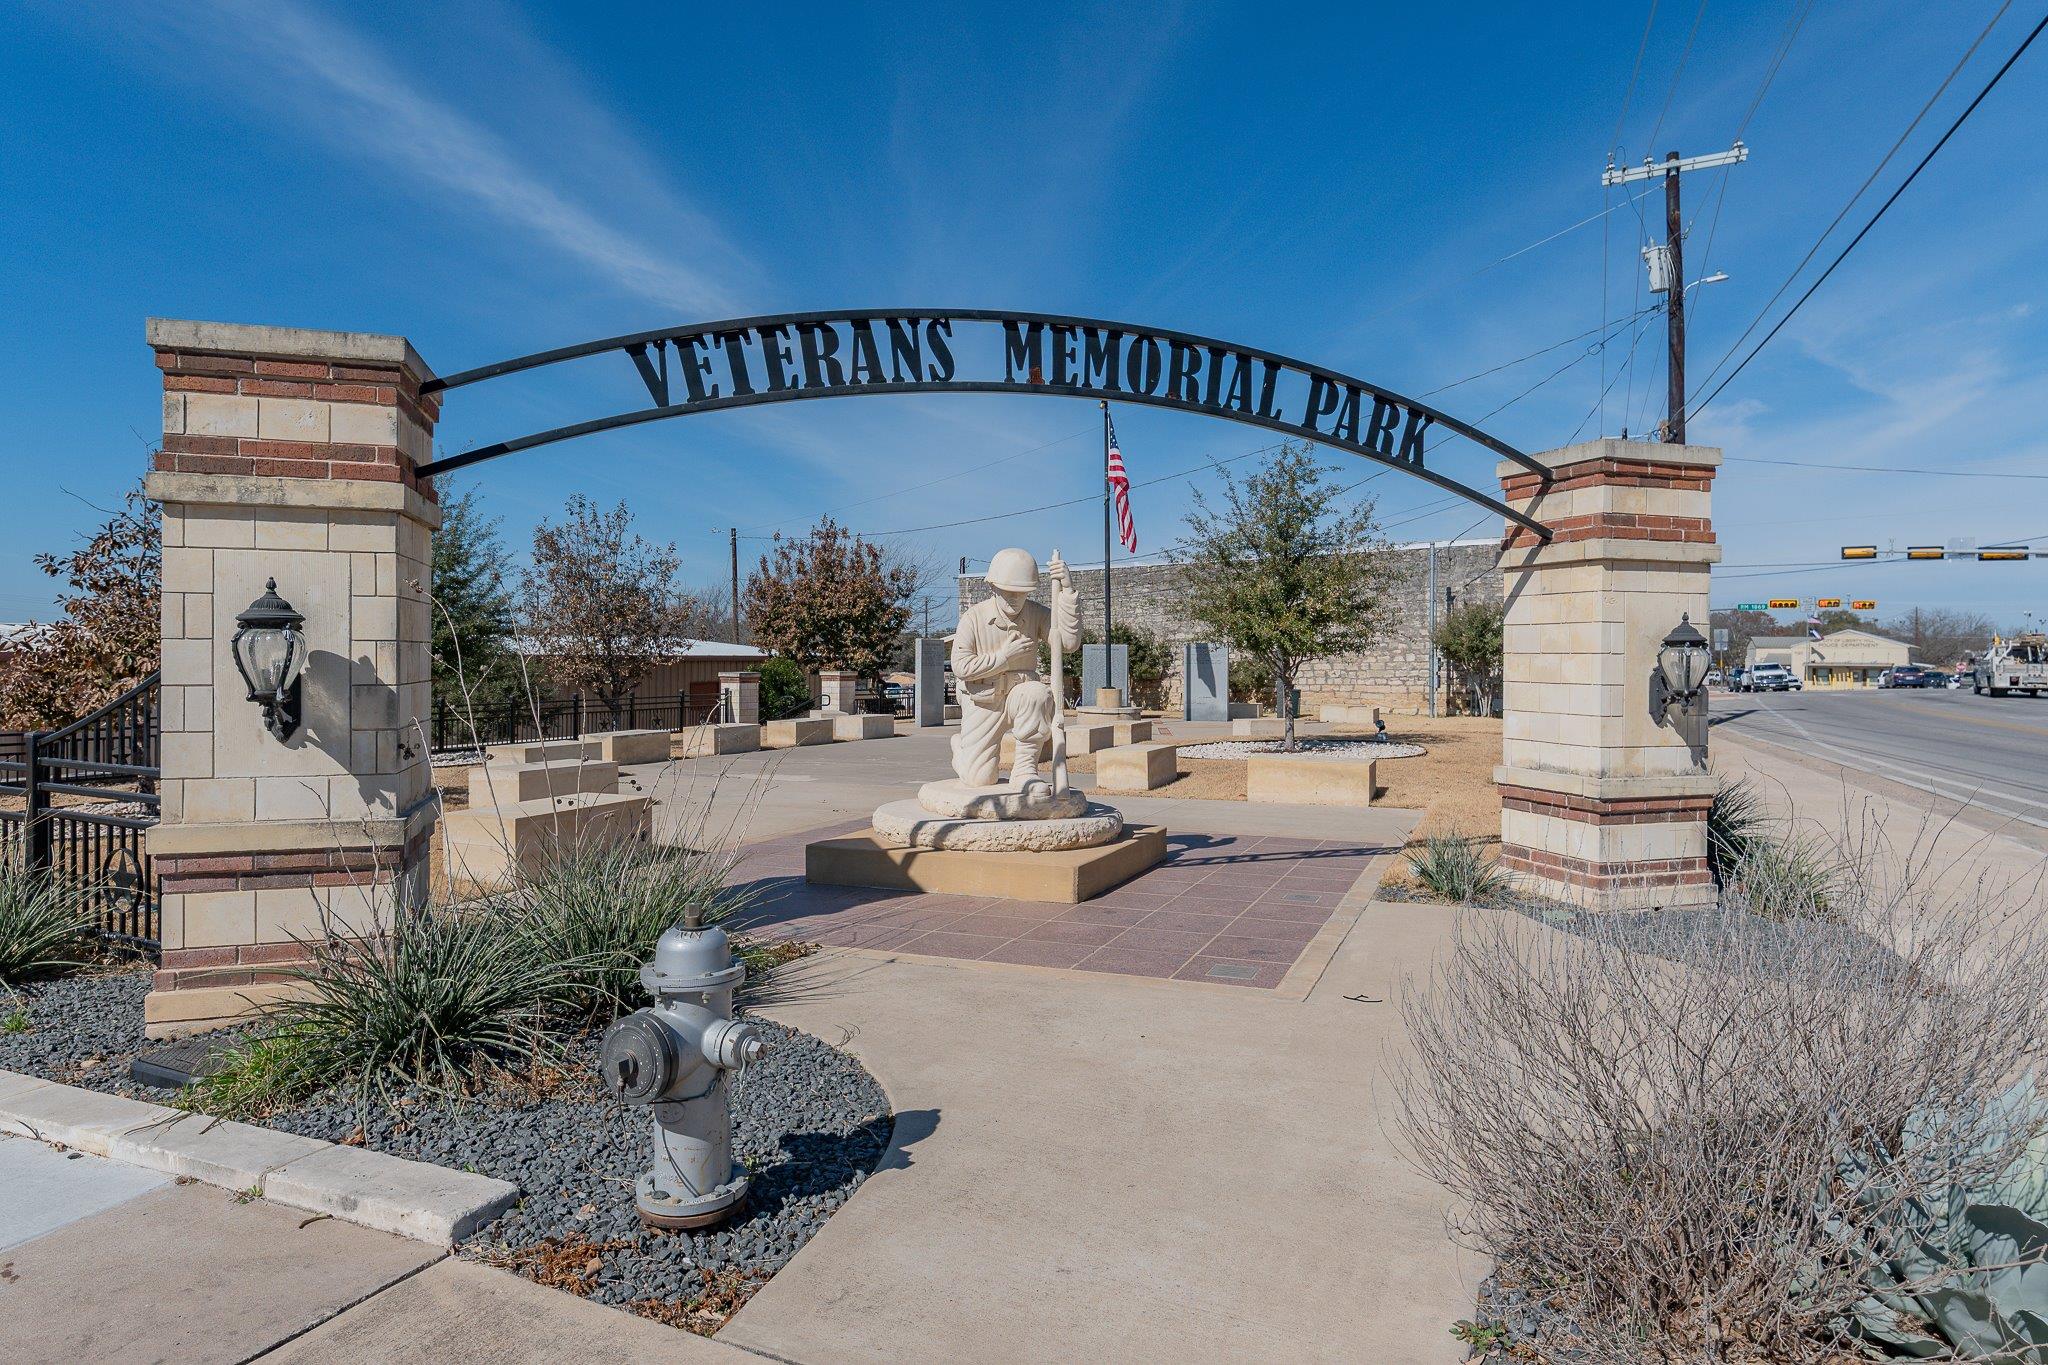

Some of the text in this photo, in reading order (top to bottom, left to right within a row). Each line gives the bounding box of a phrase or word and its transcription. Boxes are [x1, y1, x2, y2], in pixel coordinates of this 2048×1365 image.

[624, 318, 1436, 468] VETERANS MEMORIAL PARK
